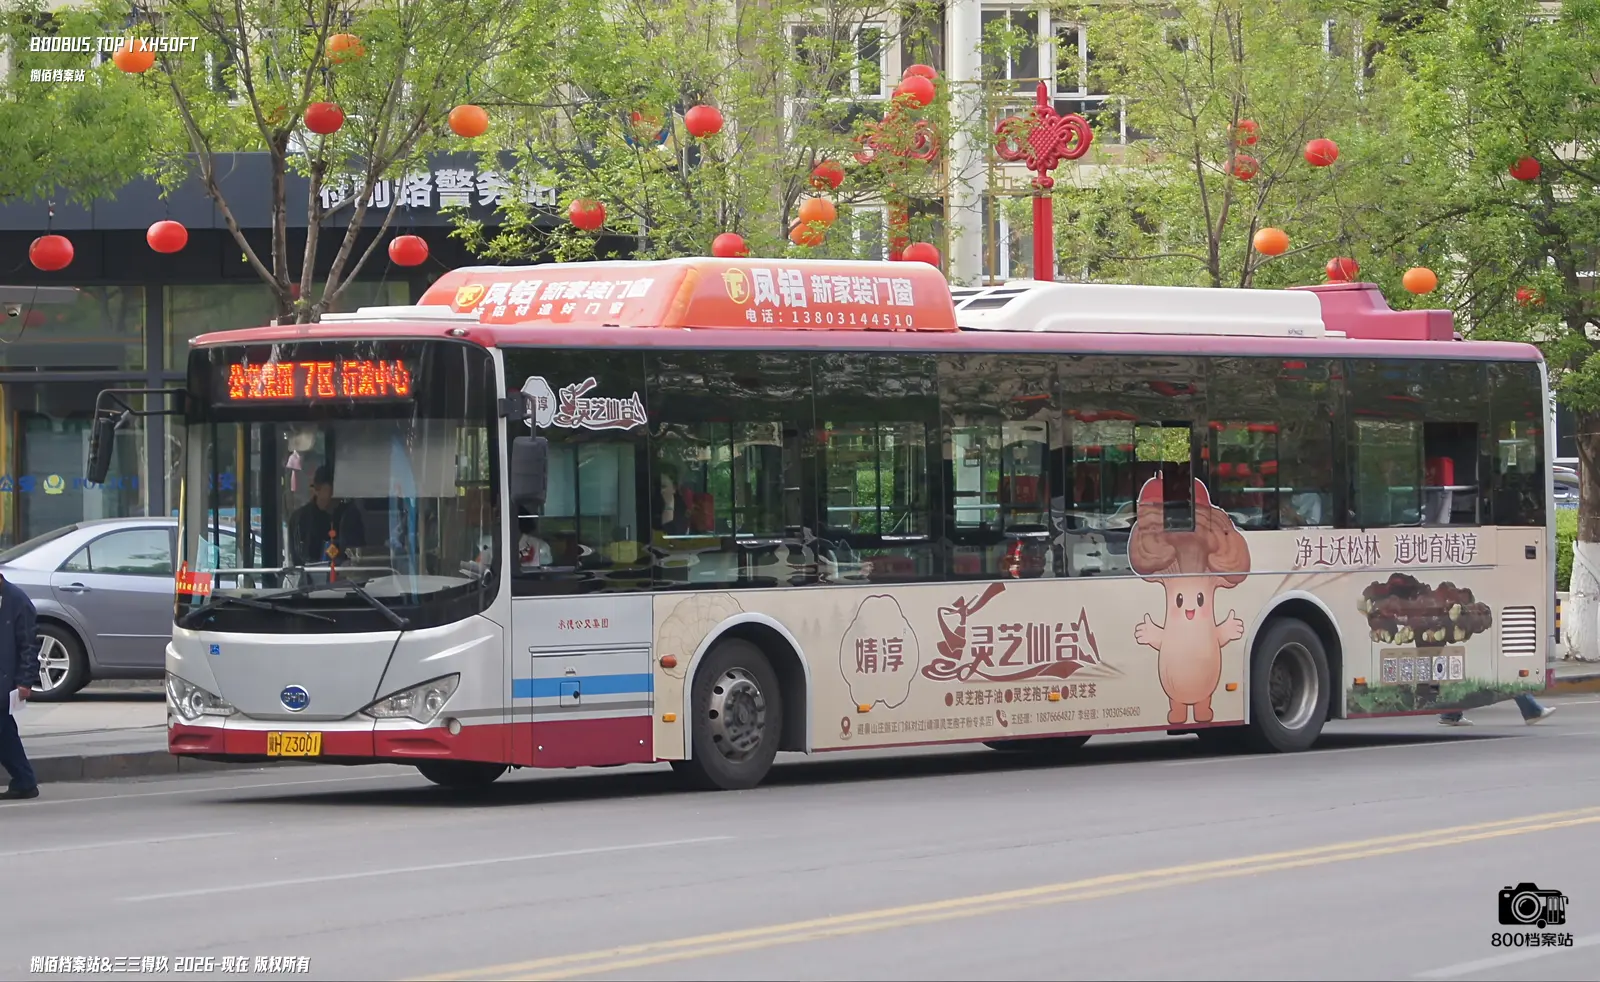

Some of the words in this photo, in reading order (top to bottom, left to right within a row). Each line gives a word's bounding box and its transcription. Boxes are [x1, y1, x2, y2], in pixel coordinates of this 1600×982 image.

[479, 279, 543, 307] 凤铝
[539, 277, 655, 301] 新家装门窗
[751, 268, 808, 308] 凤铝
[810, 274, 915, 307] 新家装门窗
[1295, 535, 1381, 567] 净土沃松林
[1394, 532, 1478, 565] 道地育婧淳
[855, 636, 904, 674] 婧淳
[955, 689, 1003, 706] 灵芝孢子油
[1069, 683, 1097, 699] 灵芝茶
